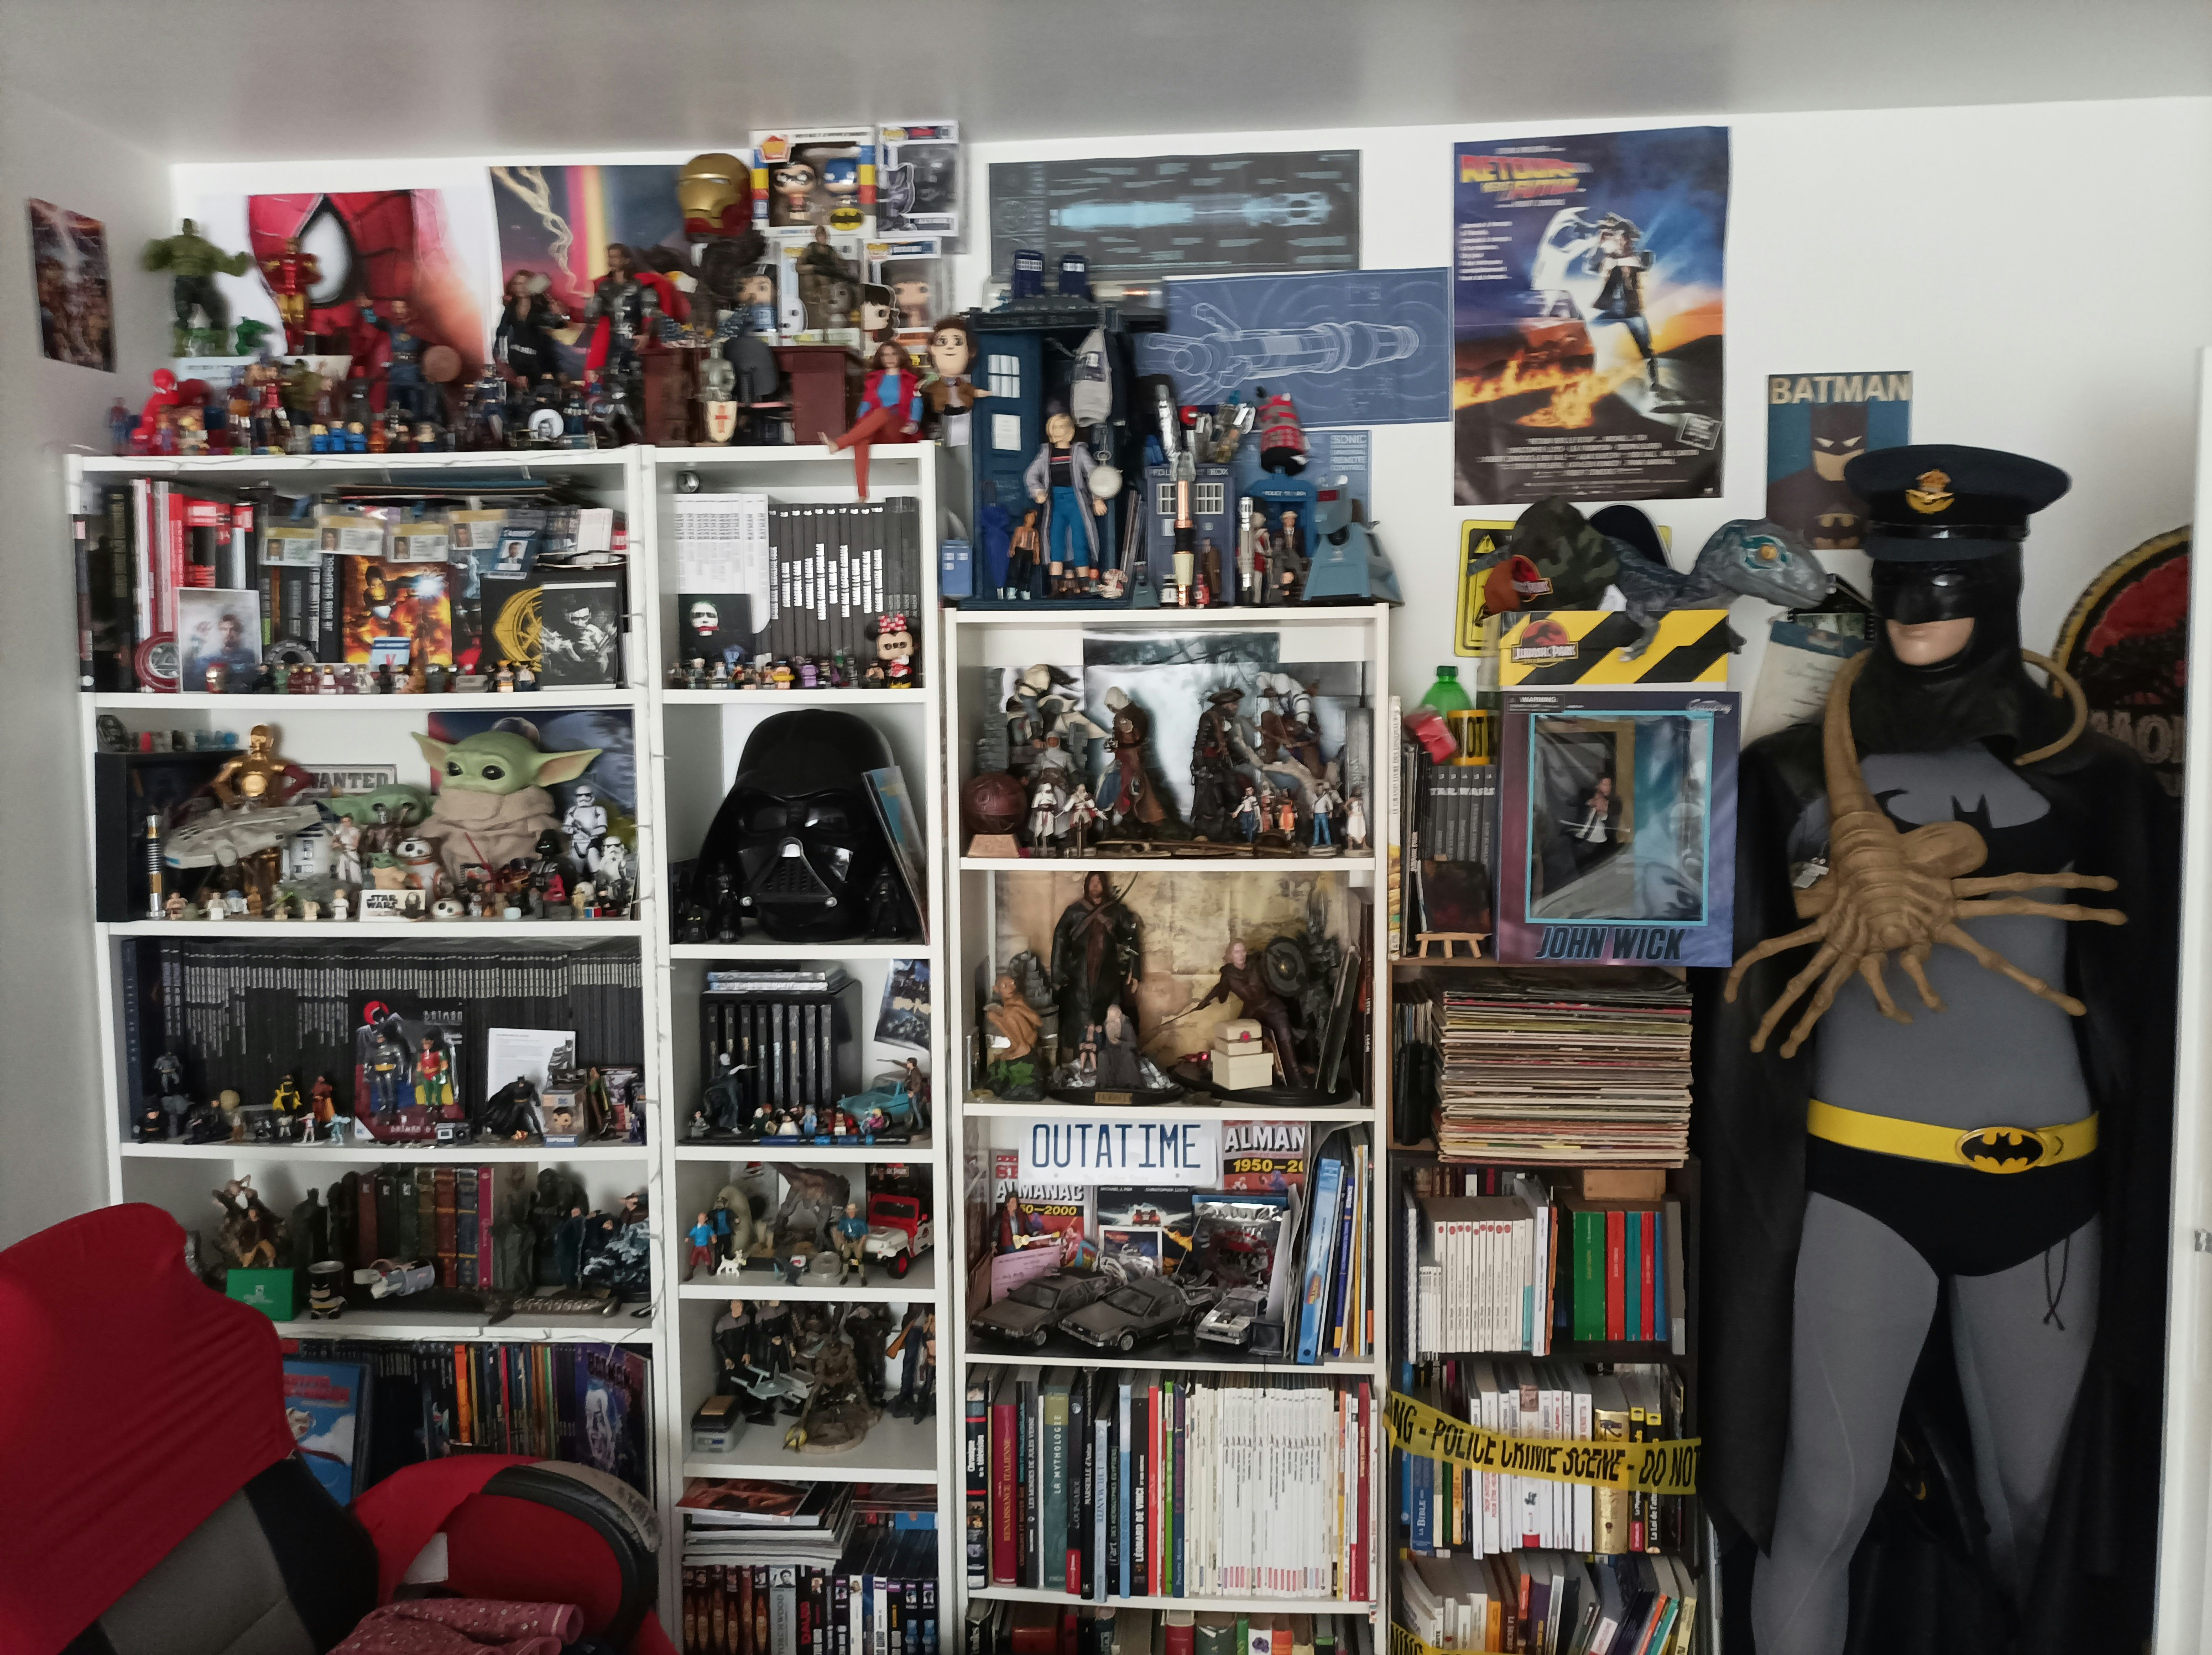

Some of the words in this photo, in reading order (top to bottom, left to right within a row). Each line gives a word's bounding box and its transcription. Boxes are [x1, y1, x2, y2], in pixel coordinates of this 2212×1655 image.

[1771, 373, 1910, 404] BATMAN
[1331, 435, 1366, 444] SONIC
[322, 555, 335, 599] DEADPOOL
[322, 601, 335, 620] SUIS
[1552, 645, 1575, 657] PARK
[367, 901, 397, 909] WARS
[1535, 925, 1608, 959] JOHN
[1613, 928, 1686, 960] WICK
[1032, 1123, 1201, 1168] OUTATIME
[1053, 1415, 1061, 1478] MYTHOLOGIE
[1431, 1417, 1496, 1465] POLICE
[1563, 1447, 1626, 1482] SCENE
[1639, 1448, 1667, 1486] DO
[1053, 1484, 1061, 1493] LA
[1135, 1487, 1144, 1510] VINCI
[1135, 1511, 1144, 1522] DE
[1416, 1500, 1426, 1527] BIBLE
[1134, 1524, 1144, 1562] LÉONARD
